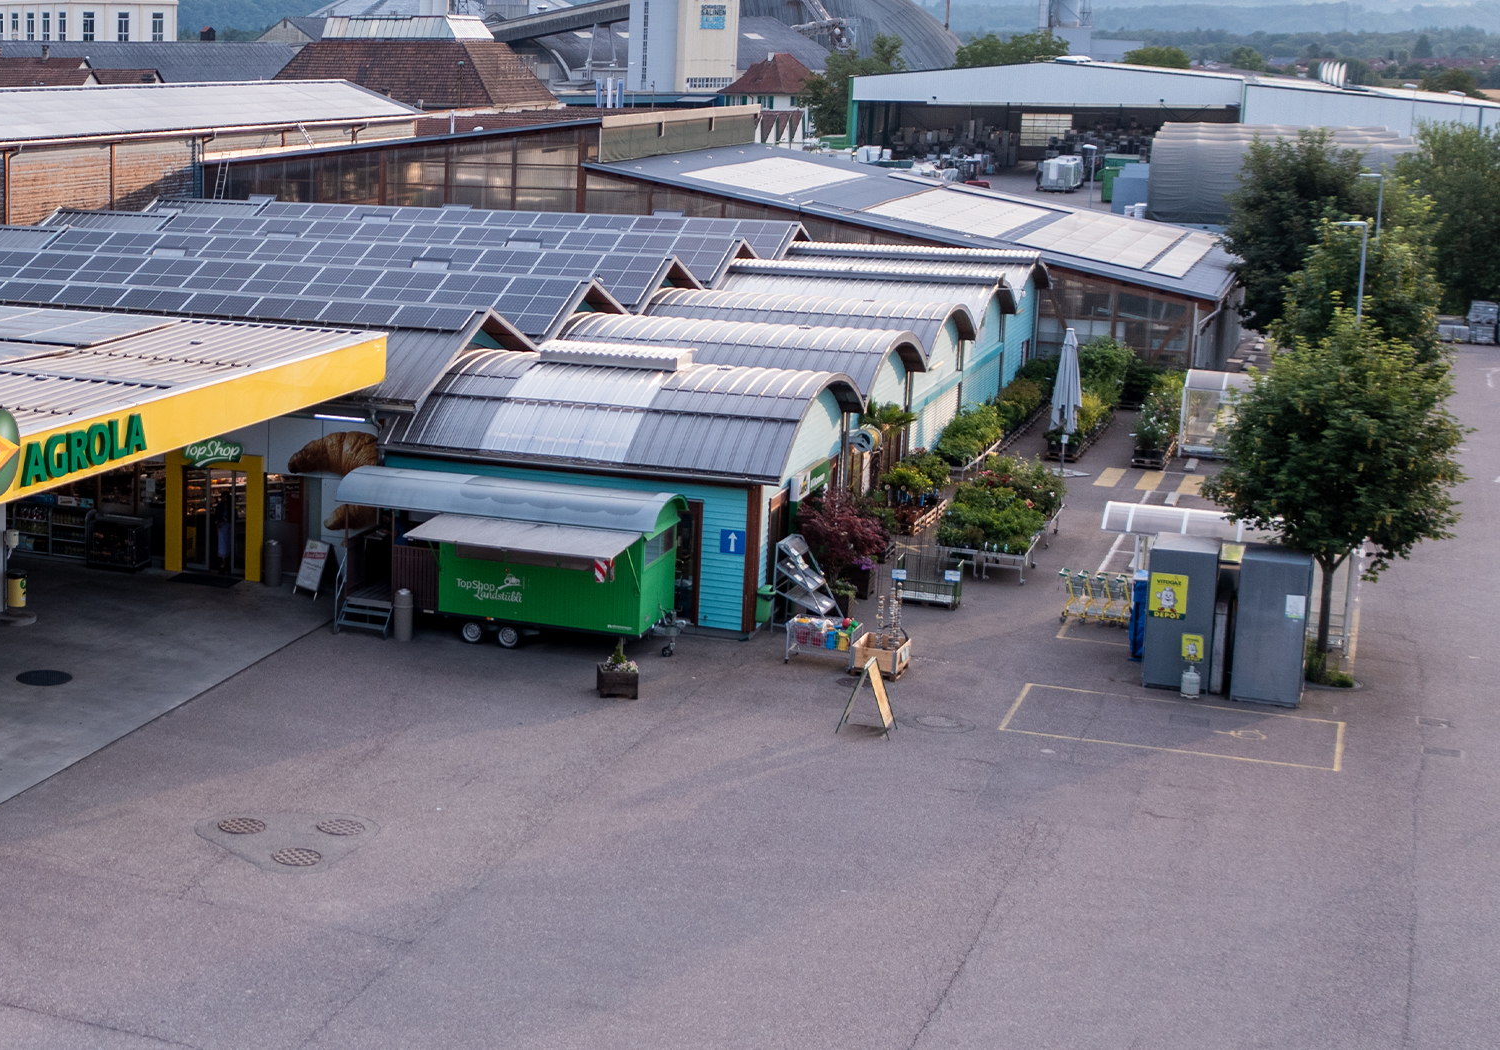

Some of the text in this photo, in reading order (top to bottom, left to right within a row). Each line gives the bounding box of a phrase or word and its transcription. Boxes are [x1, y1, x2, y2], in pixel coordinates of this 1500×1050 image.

[19, 413, 147, 487] AGROLA
[185, 440, 240, 460] TopShop
[456, 578, 495, 591] TopShop
